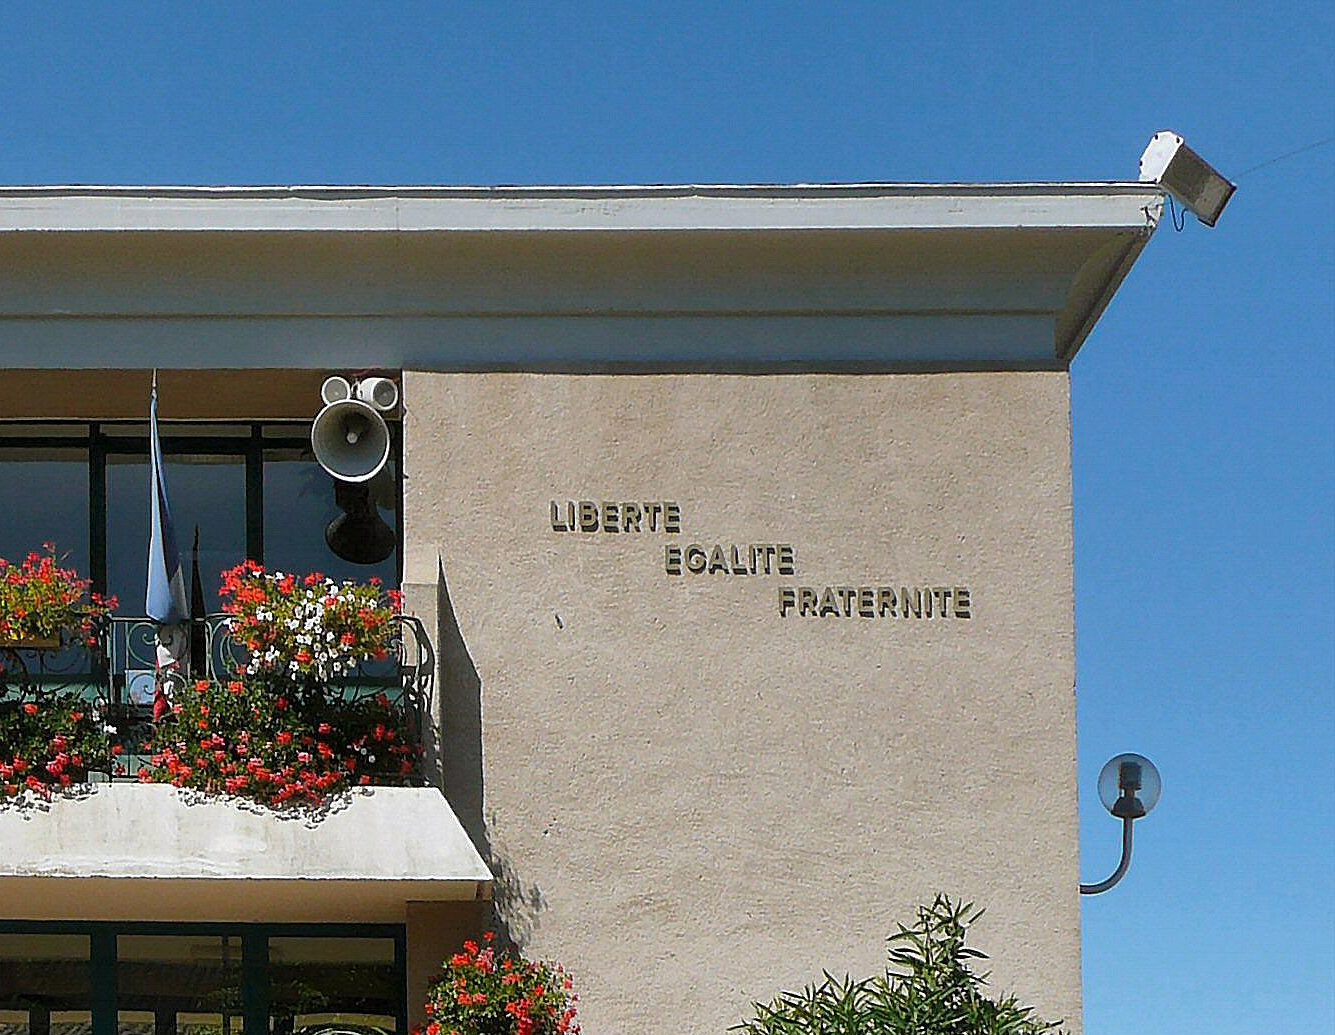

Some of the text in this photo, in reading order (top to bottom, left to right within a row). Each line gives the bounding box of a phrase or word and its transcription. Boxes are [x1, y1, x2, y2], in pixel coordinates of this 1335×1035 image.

[550, 501, 680, 531] LIBERTE
[665, 544, 794, 574] EGALITE
[778, 586, 971, 618] FRATERNITE
